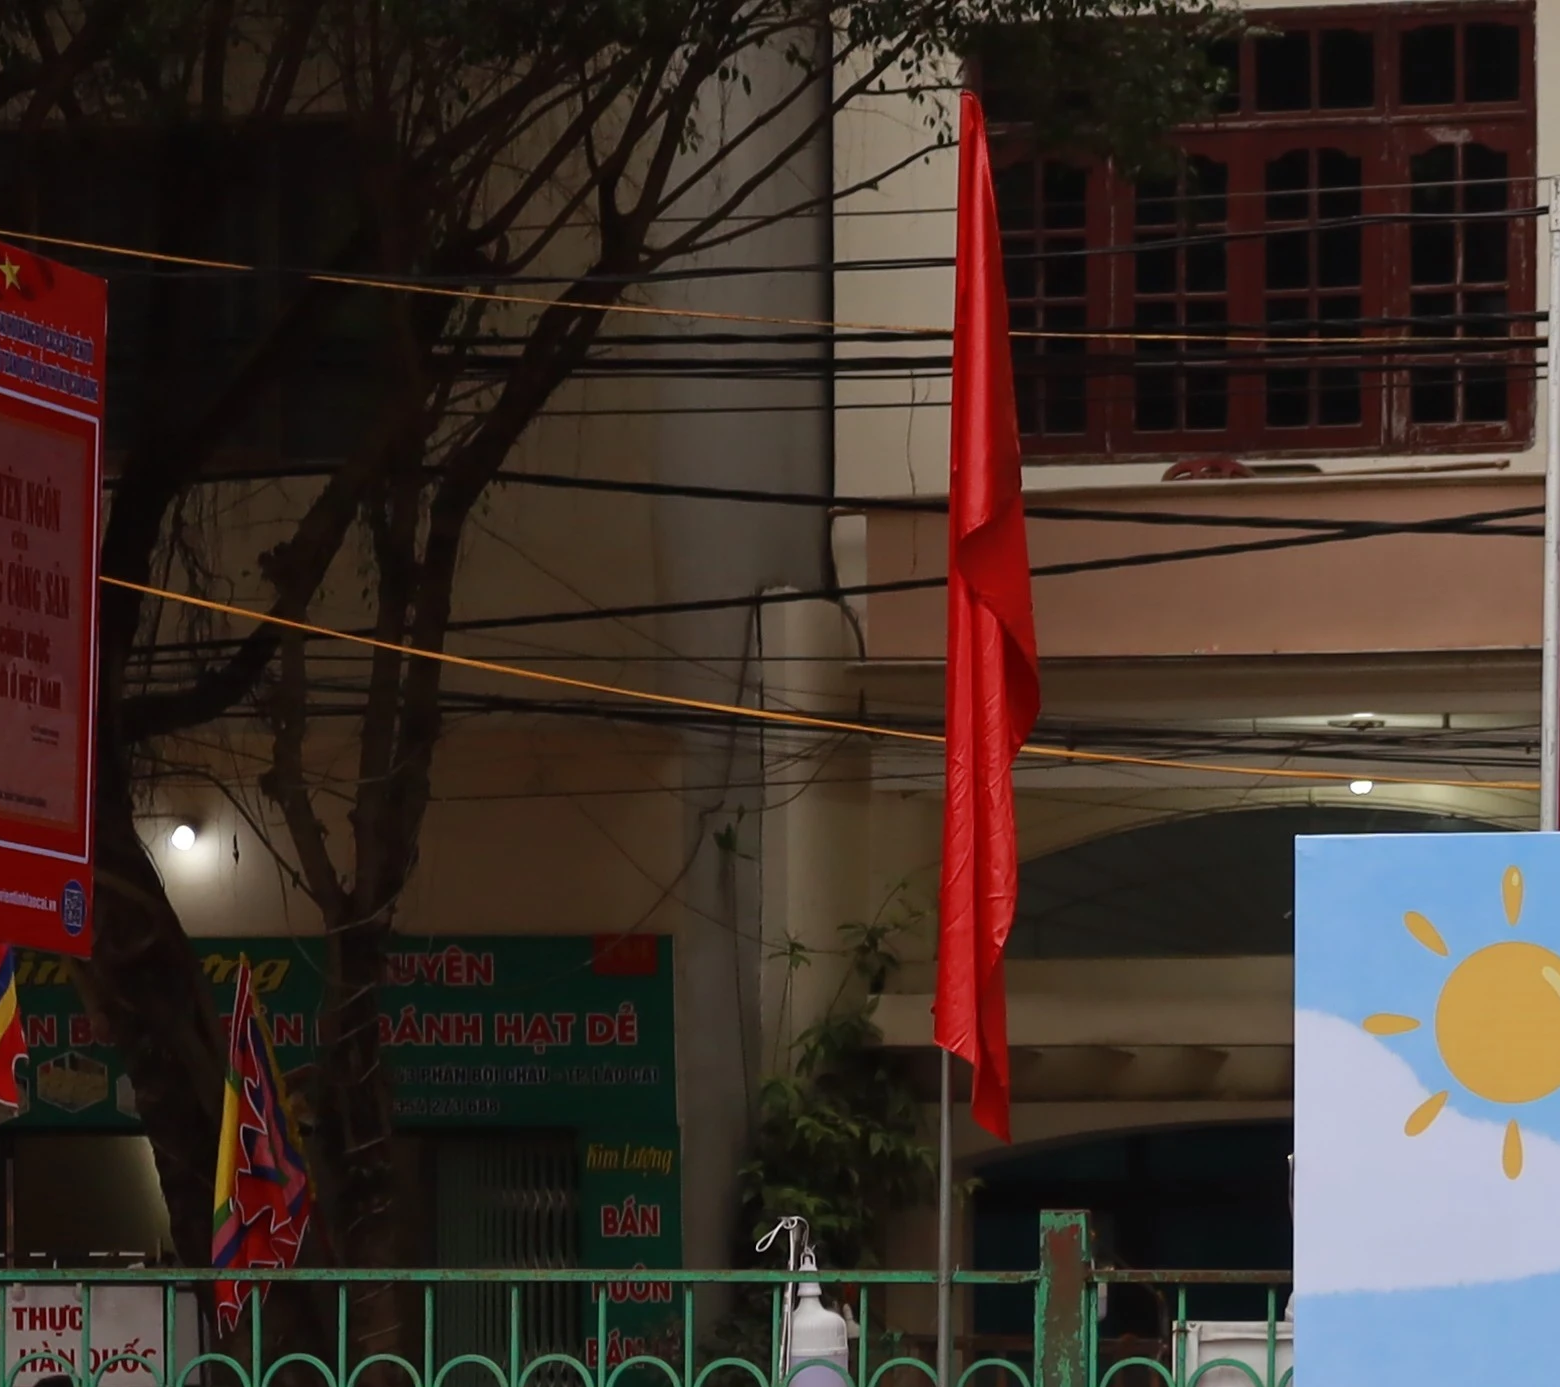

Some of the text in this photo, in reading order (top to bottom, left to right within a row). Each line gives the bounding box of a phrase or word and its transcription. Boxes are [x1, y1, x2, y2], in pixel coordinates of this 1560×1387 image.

[26, 476, 61, 532] NGÔN
[495, 1012, 576, 1055] HẠT
[586, 1001, 639, 1047] DẺ
[587, 1143, 619, 1172] Kim
[601, 1195, 661, 1238] BÁN
[591, 1263, 673, 1303] UÔN
[12, 1304, 83, 1336] THỰC
[20, 1338, 156, 1374] HÀN QUỐC
